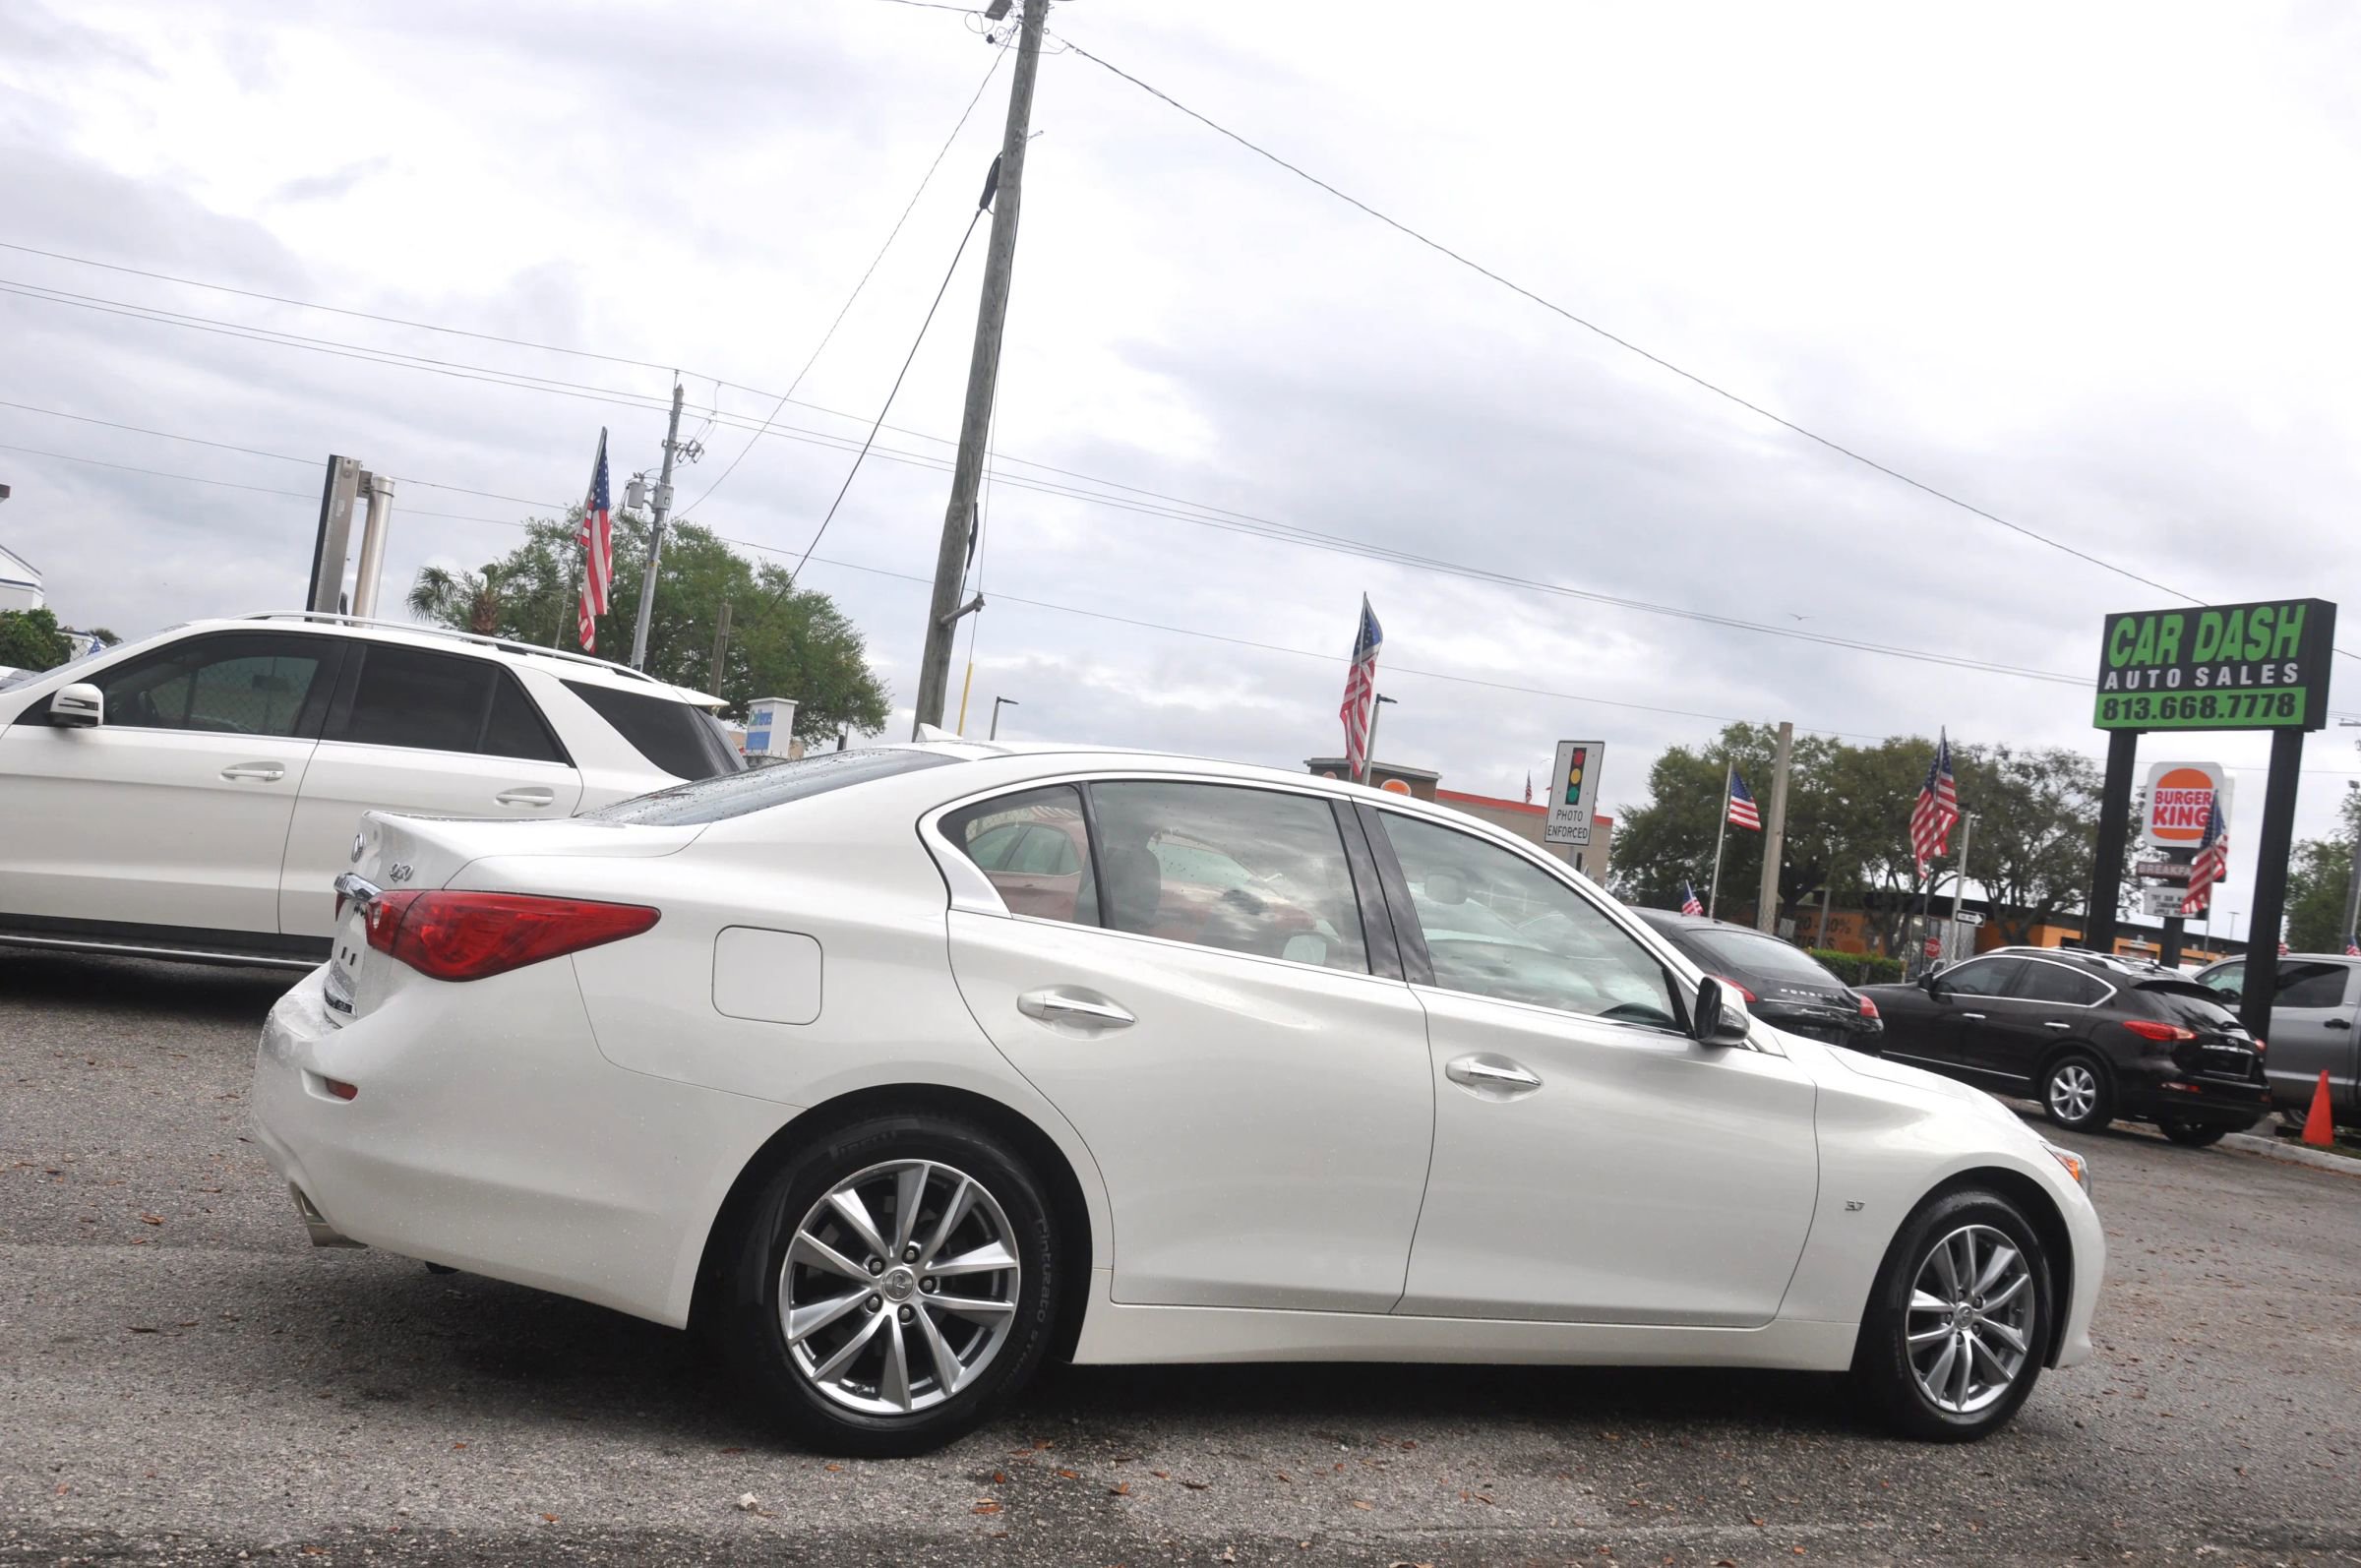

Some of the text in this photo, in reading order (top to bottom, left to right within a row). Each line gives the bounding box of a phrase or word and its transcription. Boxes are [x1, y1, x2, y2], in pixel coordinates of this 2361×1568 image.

[2109, 605, 2306, 667] CAR DASH
[2104, 663, 2298, 691] AUTO SALES
[2102, 693, 2296, 720] 813.668.7778
[2154, 790, 2212, 806] BURGER
[1556, 810, 1583, 822] PHOTO
[2151, 806, 2210, 827] KING
[1547, 825, 1588, 839] ENFORCED
[2138, 864, 2192, 876] BREAKFA
